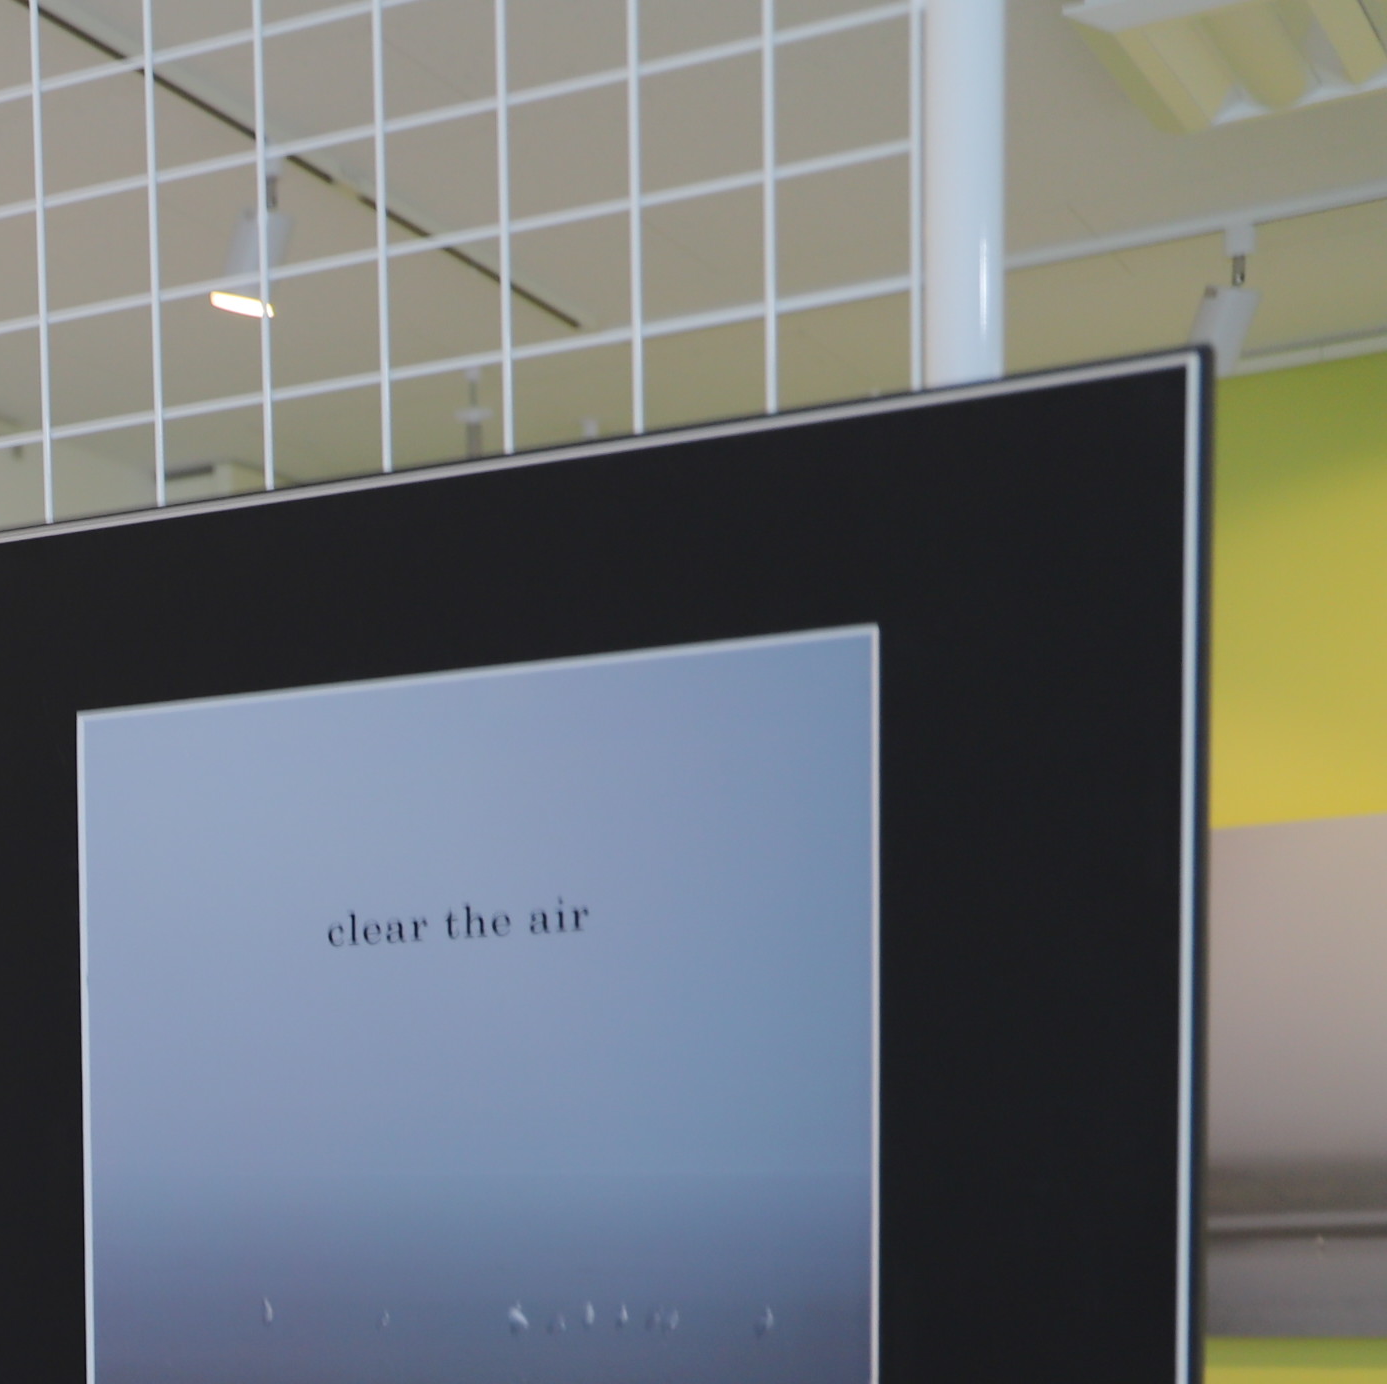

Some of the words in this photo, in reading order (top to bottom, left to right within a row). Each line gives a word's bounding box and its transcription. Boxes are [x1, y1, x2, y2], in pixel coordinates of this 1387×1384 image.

[327, 909, 428, 947] clear
[444, 900, 511, 940] the
[529, 896, 590, 935] air
